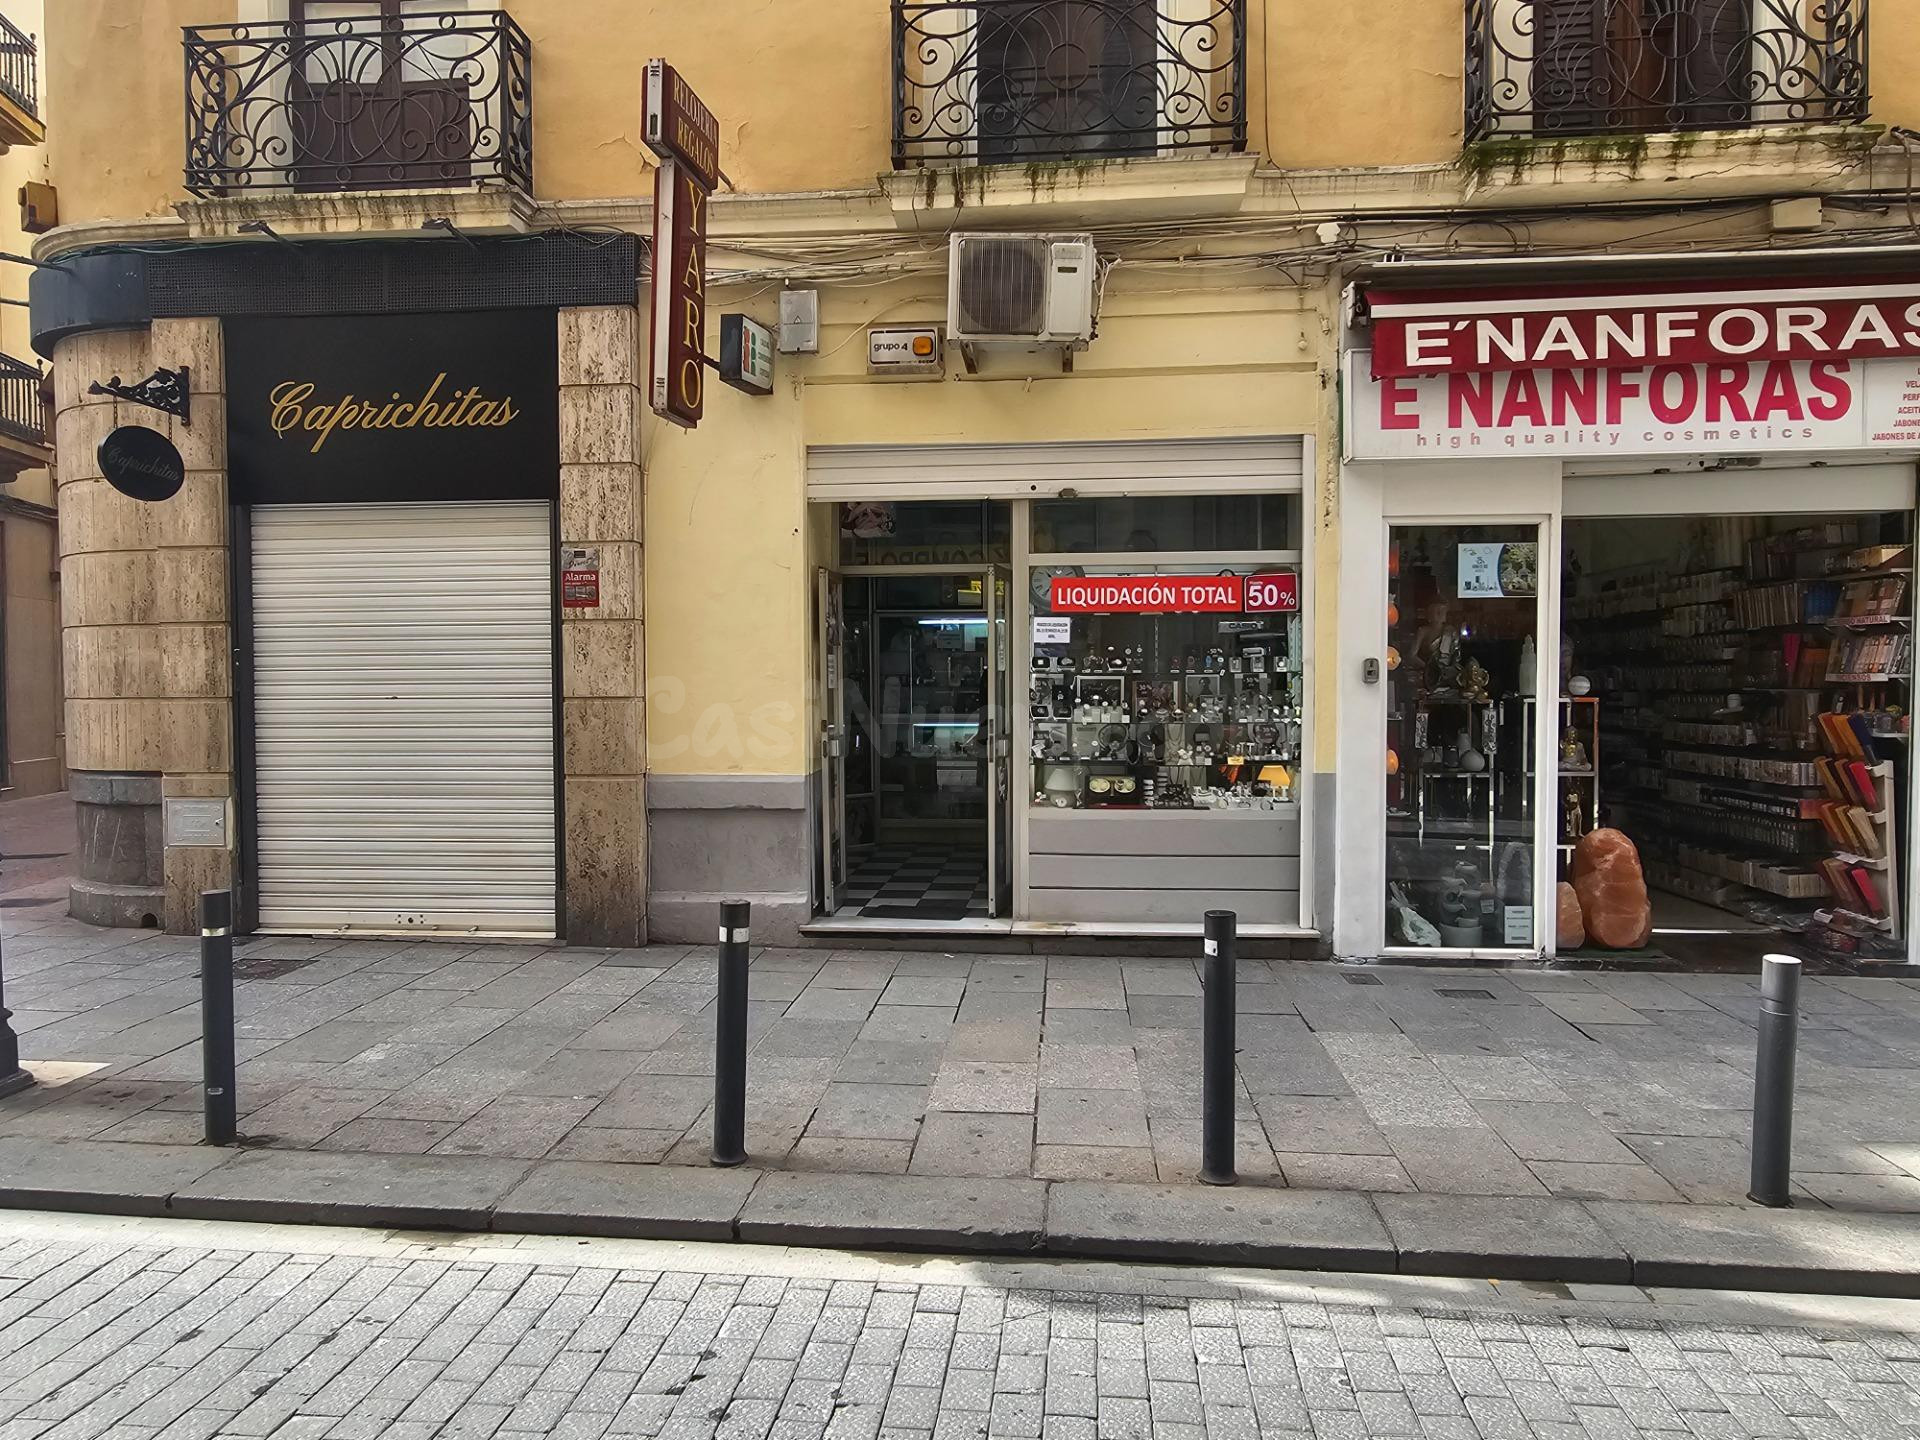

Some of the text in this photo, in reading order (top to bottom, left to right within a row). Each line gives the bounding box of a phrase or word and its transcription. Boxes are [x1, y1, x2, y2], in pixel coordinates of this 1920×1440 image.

[678, 116, 713, 179] REGALOS
[873, 343, 900, 351] grupo
[1381, 359, 1852, 428] ENANFORAS
[270, 373, 520, 452] Caprichitas
[1416, 425, 1813, 449] high quality cosmetics
[1872, 433, 1905, 441] JABONES
[1907, 432, 1916, 440] DE
[565, 573, 596, 581] Alarma
[1058, 582, 1237, 607] LIQUIDACIÓN TOTAL
